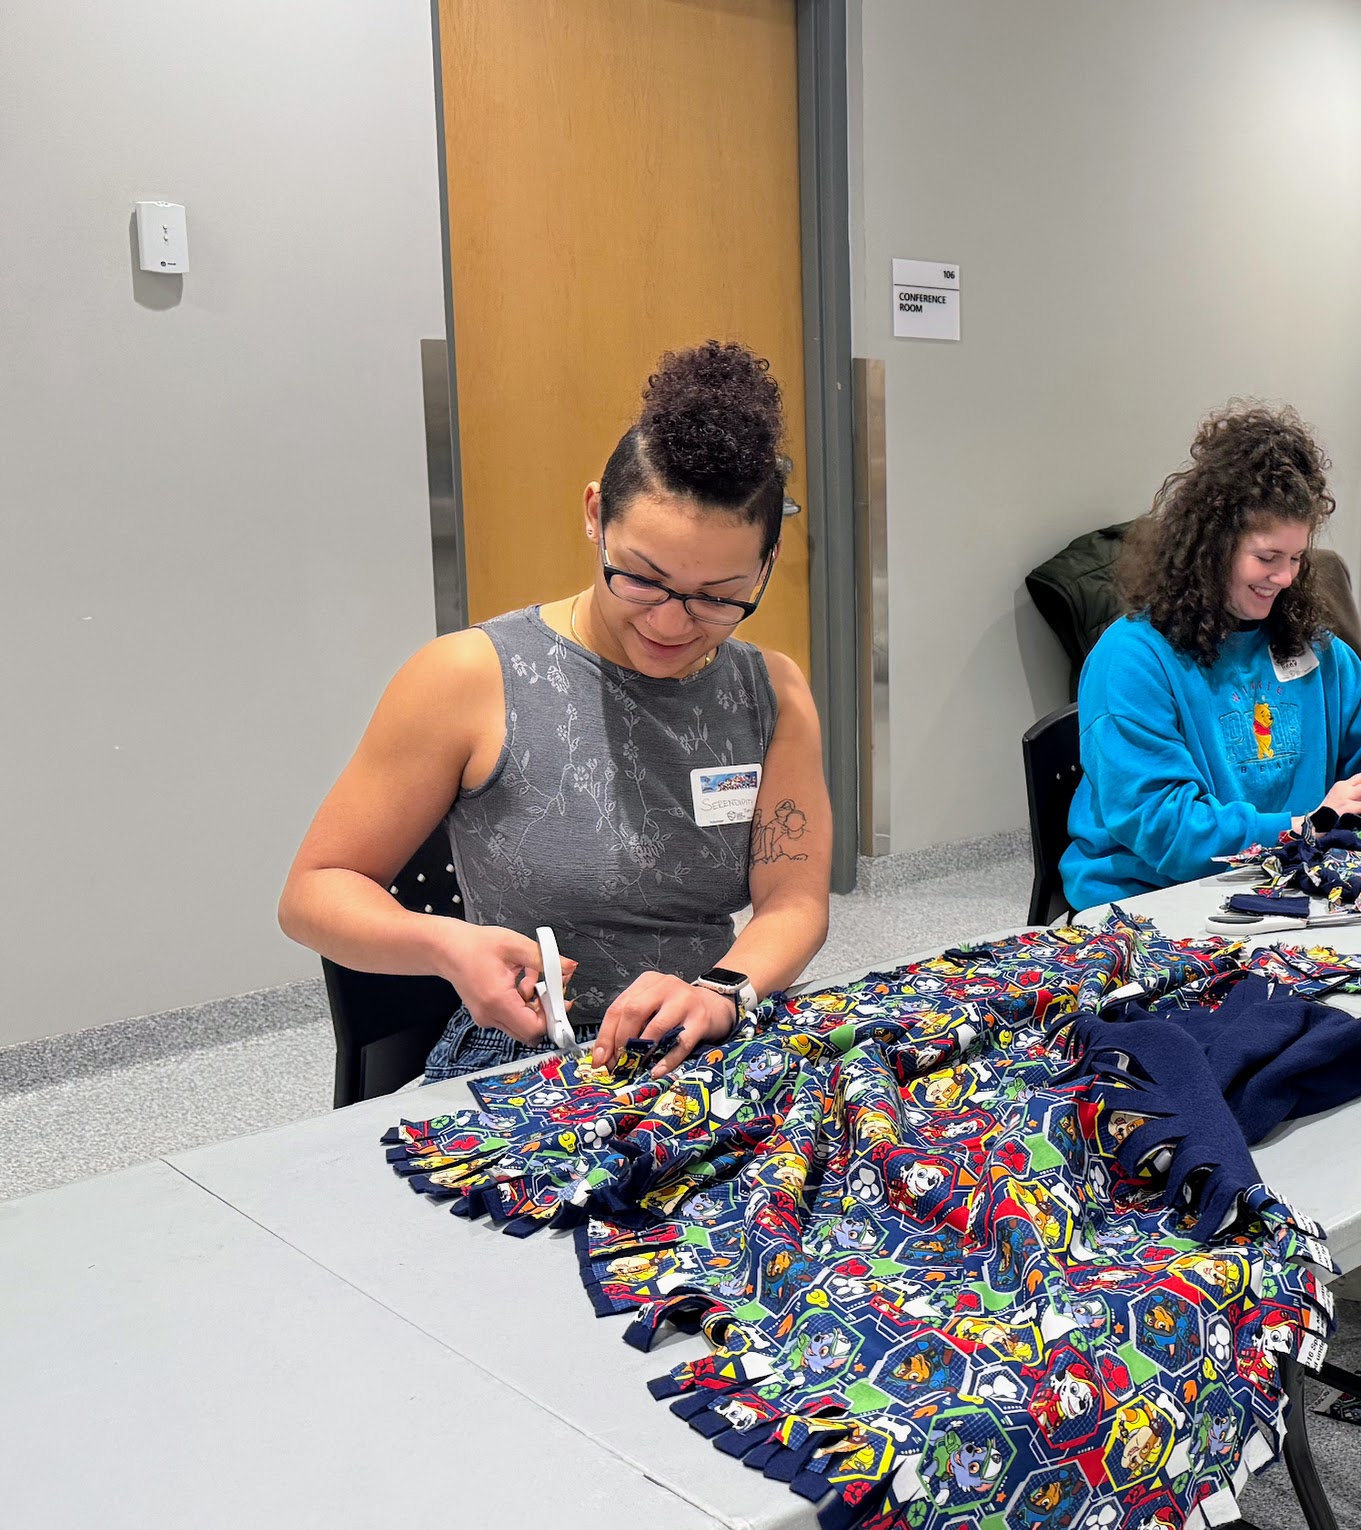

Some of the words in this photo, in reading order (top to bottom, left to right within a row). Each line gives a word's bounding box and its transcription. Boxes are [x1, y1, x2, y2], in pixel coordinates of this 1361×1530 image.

[943, 270, 955, 279] 106
[899, 293, 946, 304] CONFERENCE
[899, 303, 923, 313] ROOM
